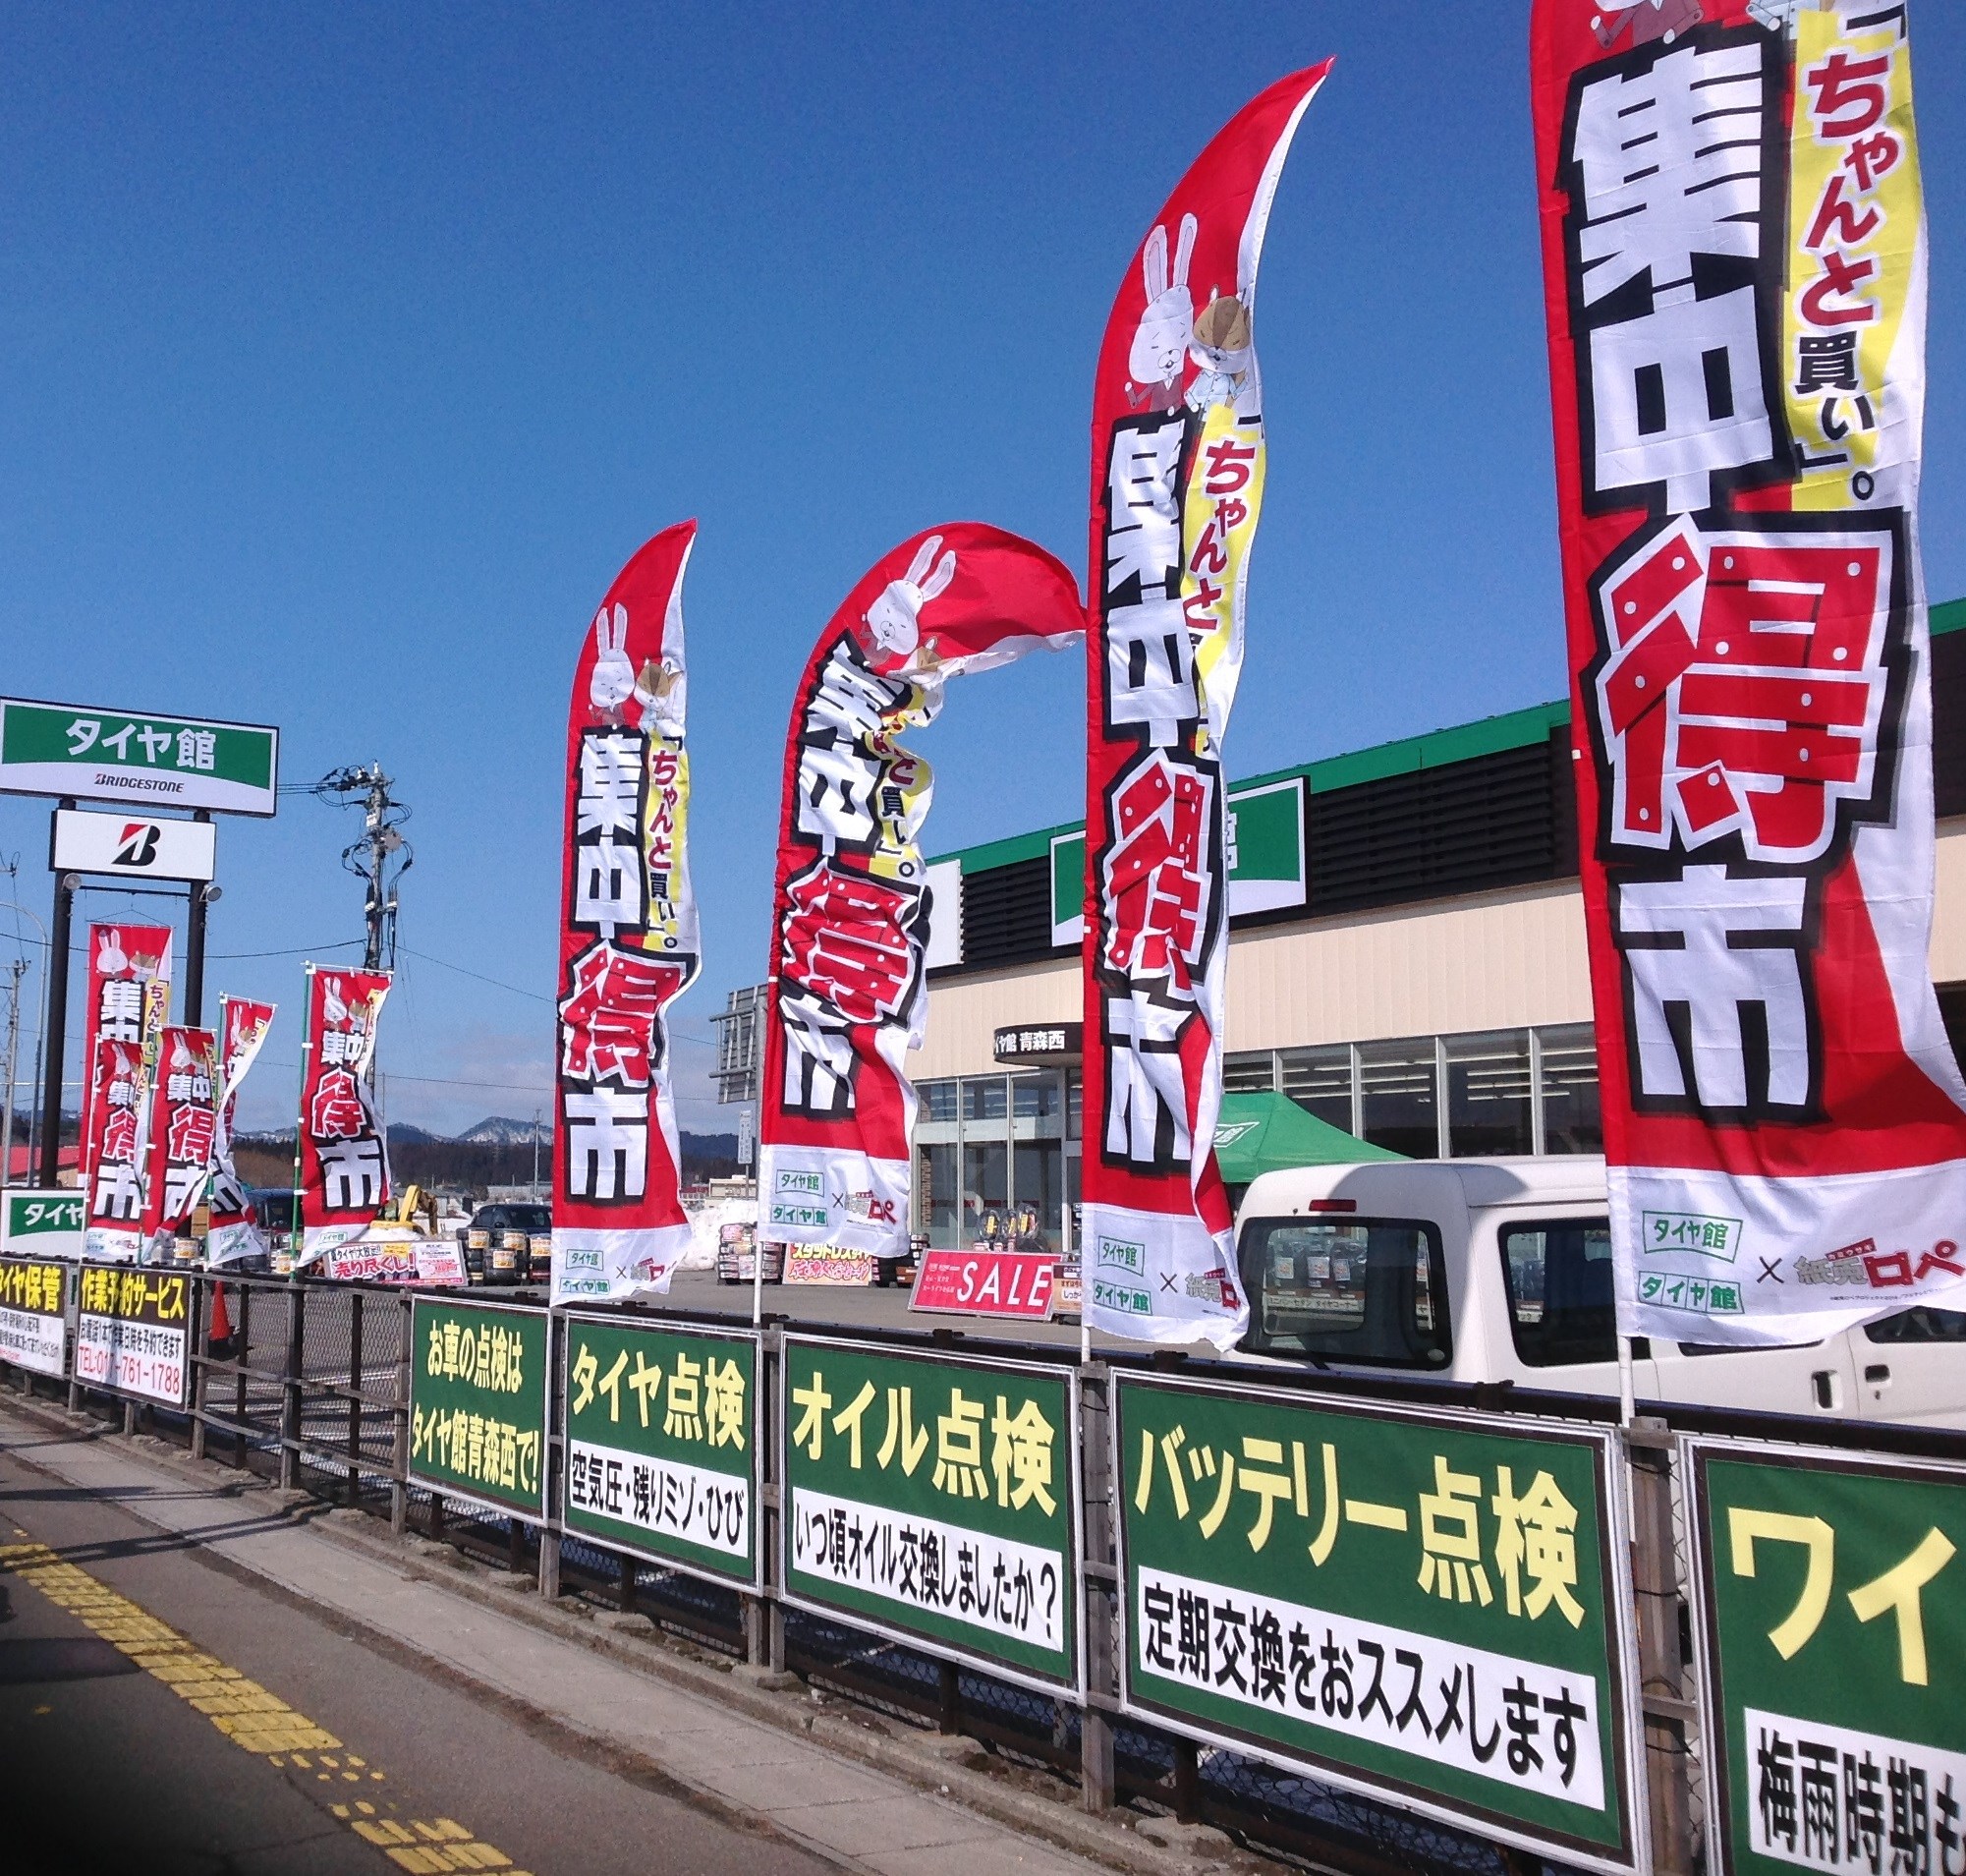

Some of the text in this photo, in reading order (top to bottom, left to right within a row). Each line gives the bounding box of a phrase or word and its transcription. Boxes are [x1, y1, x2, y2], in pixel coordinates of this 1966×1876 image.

[65, 718, 217, 771] タイヤ館
[94, 772, 185, 794] BRIDGESTONE
[1019, 1030, 1066, 1052] 青森西
[167, 1073, 211, 1103] 集中
[781, 1173, 819, 1190] タイヤ館
[24, 1203, 85, 1226] タイヤ
[772, 1206, 826, 1224] タイヤ館
[1654, 1219, 1729, 1251] タイヤ館
[572, 1252, 598, 1266] タイヤ館
[1102, 1242, 1137, 1267] タイヤ館
[82, 1269, 185, 1320] 作業予約サービス
[563, 1279, 608, 1293] タイヤ館
[956, 1261, 1052, 1307] SALE
[1095, 1283, 1150, 1312] タイヤ館
[1642, 1276, 1738, 1310] タイヤ館
[427, 1319, 524, 1393] お車の点検は
[572, 1342, 746, 1451] タイヤ点検
[412, 1402, 539, 1494] タイヤ館青森西で!
[792, 1371, 1057, 1517] オイル点検
[571, 1449, 745, 1547] 空気圧・残りミゾ・ひび
[1134, 1424, 1586, 1628] バッテリー点検
[795, 1503, 1057, 1639] いつ頃オイル交換しましたか?
[1727, 1506, 1958, 1687] ワイ
[1143, 1582, 1588, 1789] 定期交換をおススメします
[1757, 1726, 1966, 1876] 梅雨時期も
